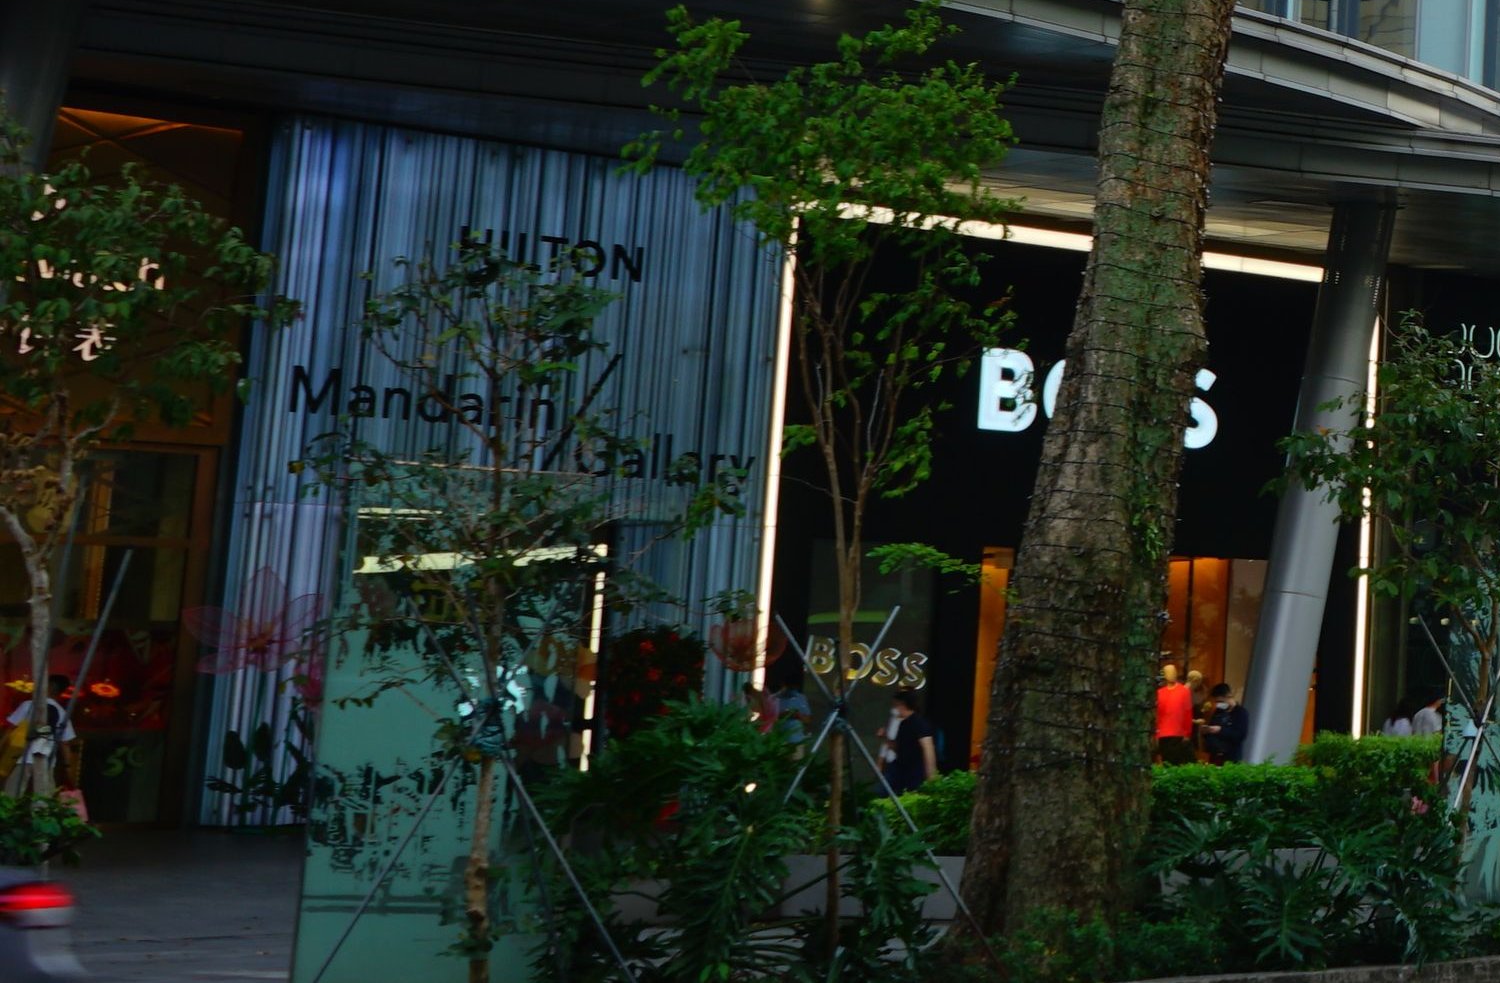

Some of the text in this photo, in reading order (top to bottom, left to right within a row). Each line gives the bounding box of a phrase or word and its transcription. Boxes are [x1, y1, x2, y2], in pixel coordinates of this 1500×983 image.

[460, 225, 644, 282] HILTON
[289, 365, 555, 431] Mandarin
[977, 347, 1218, 449] BS
[803, 634, 929, 691] BOSS
